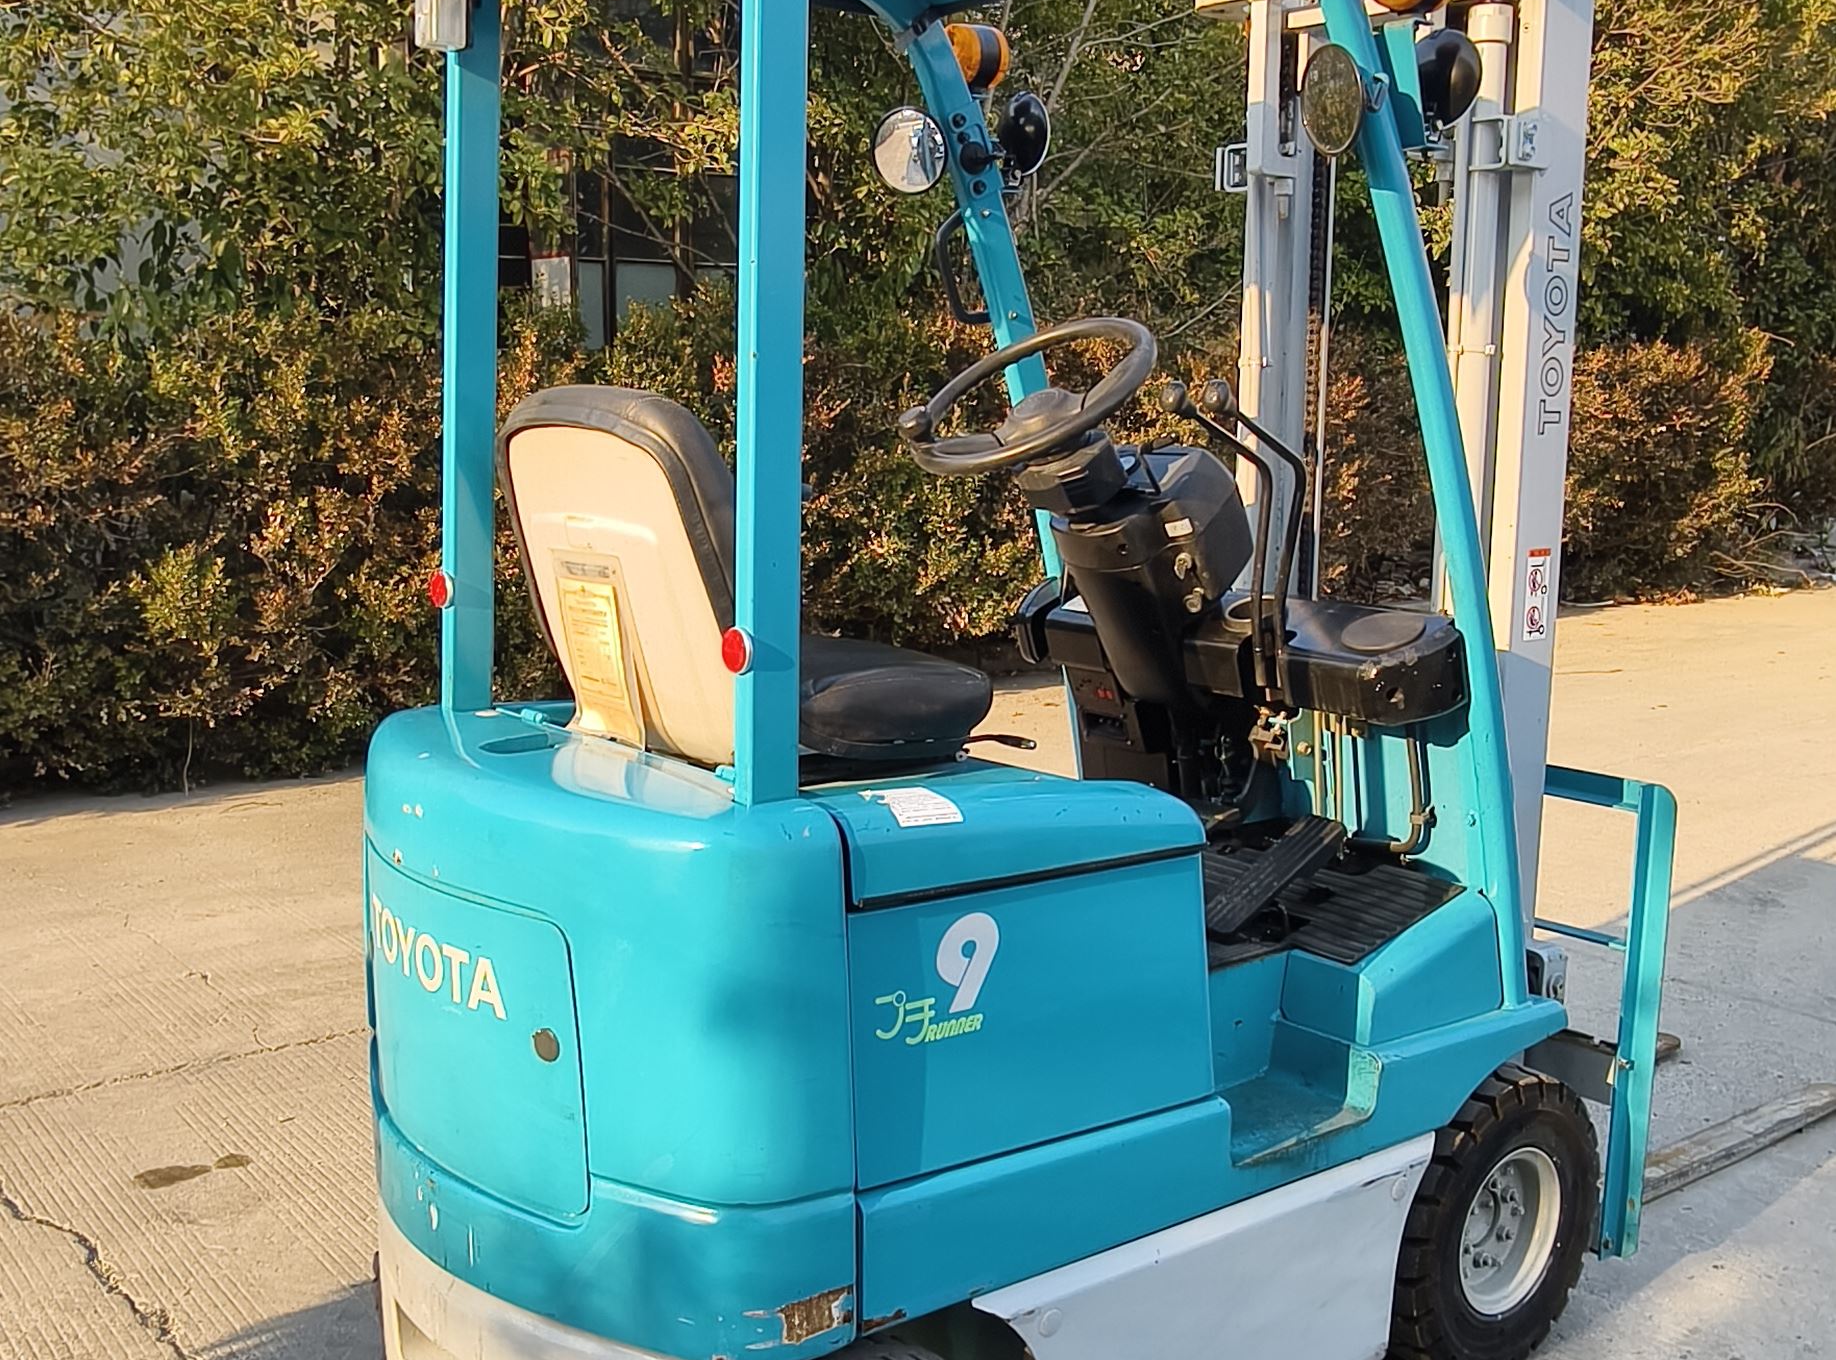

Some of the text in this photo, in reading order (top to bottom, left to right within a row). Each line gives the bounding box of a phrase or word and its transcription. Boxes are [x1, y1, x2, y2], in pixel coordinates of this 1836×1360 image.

[1538, 192, 1573, 435] TOYOTA
[372, 892, 507, 1021] TOYOTA
[936, 912, 1000, 1013] 9
[924, 1013, 983, 1042] RUNNER
